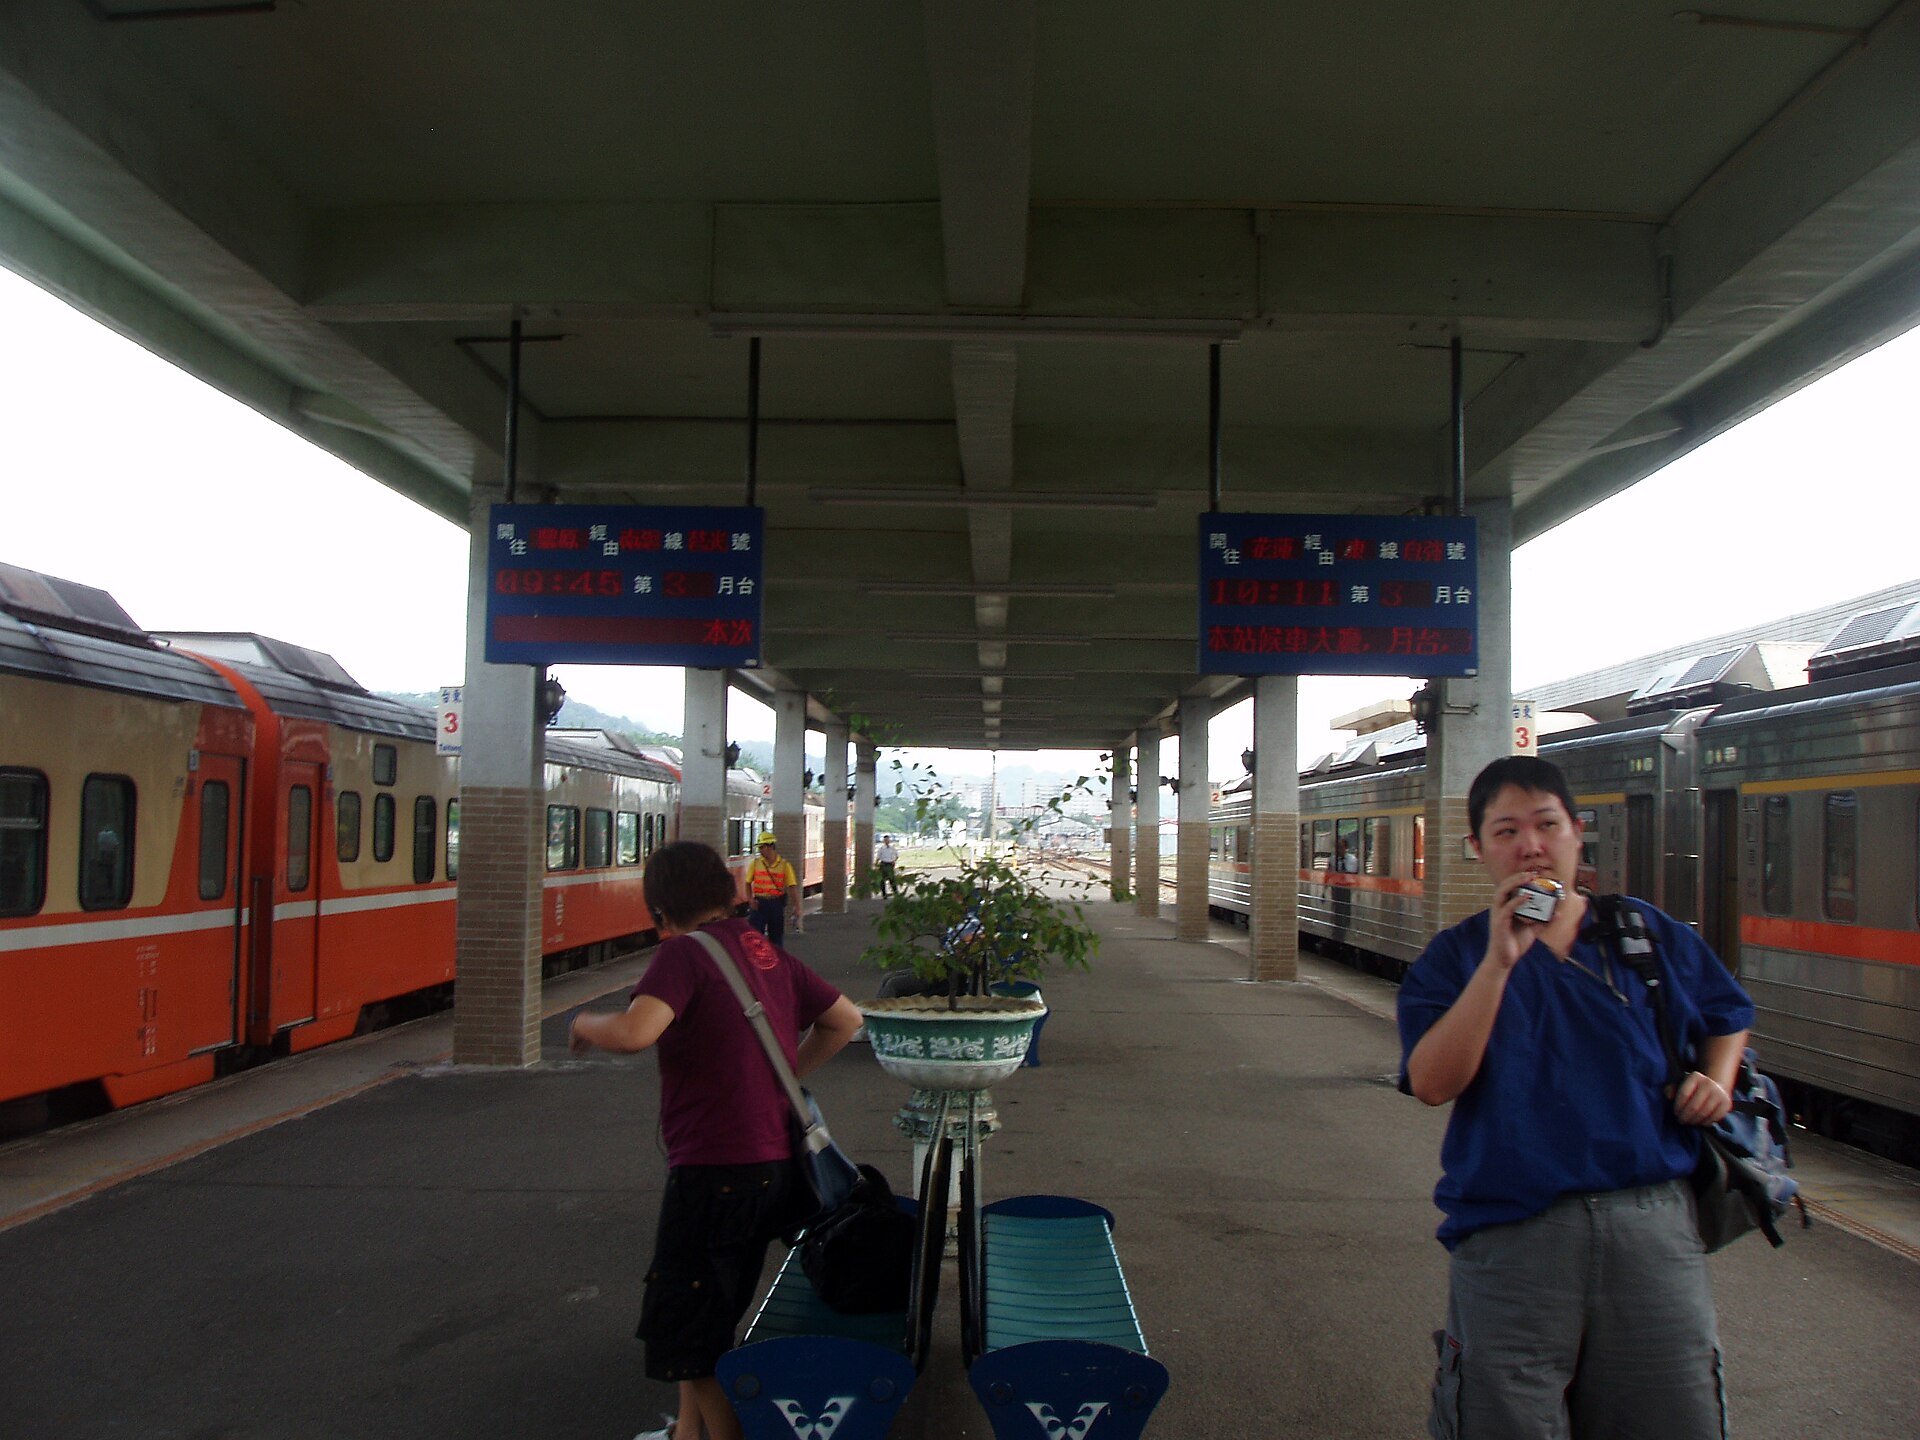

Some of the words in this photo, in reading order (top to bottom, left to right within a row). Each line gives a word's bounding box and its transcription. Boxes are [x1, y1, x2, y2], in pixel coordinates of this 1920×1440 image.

[497, 523, 528, 556] 開往
[590, 524, 619, 556] 經由
[664, 532, 684, 551] 線
[732, 532, 751, 551] 號
[1209, 533, 1240, 565] 開往
[1303, 534, 1335, 566] 經由
[1379, 541, 1399, 560] 線
[1447, 542, 1467, 561] 號
[498, 570, 623, 594] 09:45
[634, 575, 653, 594] 第
[664, 572, 685, 595] 3
[717, 576, 755, 595] 月台
[1211, 579, 1334, 606] 10:11
[1350, 585, 1369, 603] 第
[1435, 586, 1472, 604] 月台
[443, 711, 459, 734] 3
[1514, 726, 1530, 748] 3
[763, 785, 771, 794] 2
[1212, 793, 1219, 802] 2
